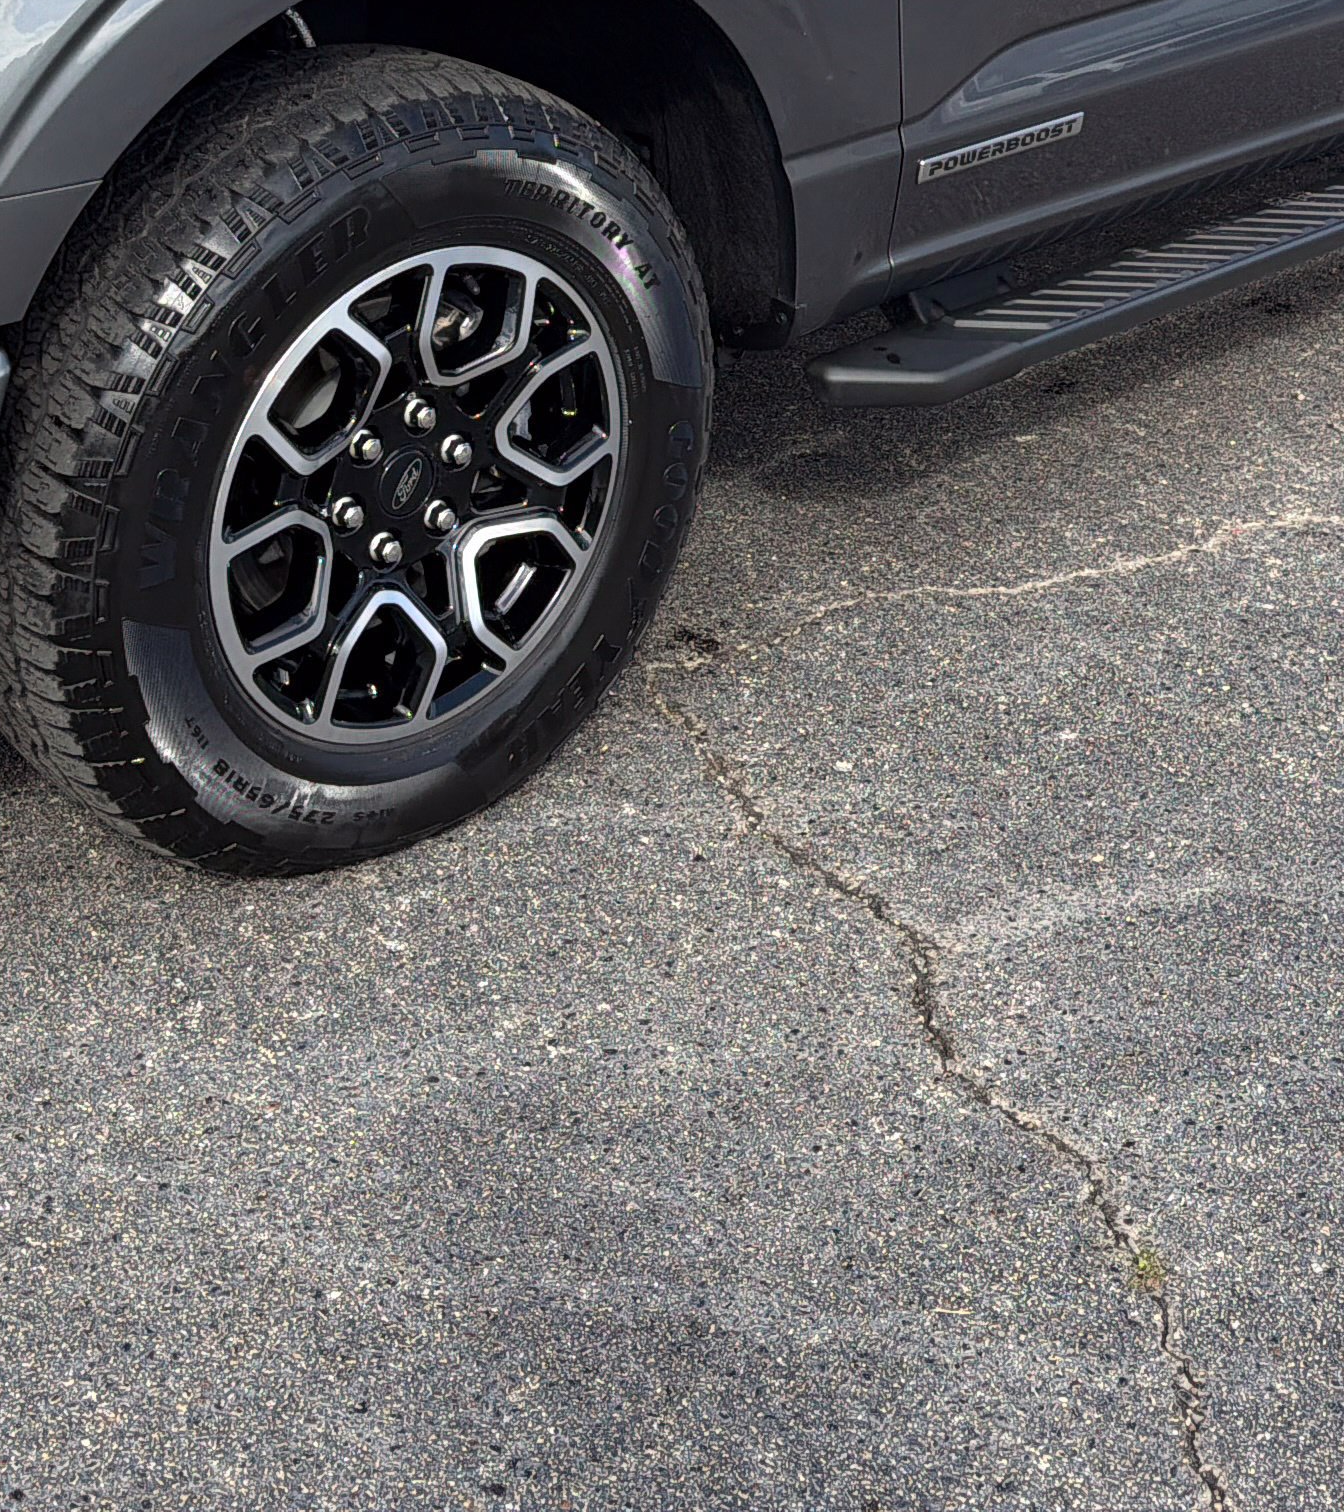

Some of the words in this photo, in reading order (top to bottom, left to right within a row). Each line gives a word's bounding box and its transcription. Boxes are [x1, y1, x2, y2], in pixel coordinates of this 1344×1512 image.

[928, 118, 1078, 177] POWERBOOST
[504, 178, 634, 251] TERRITORY
[633, 261, 662, 290] AT
